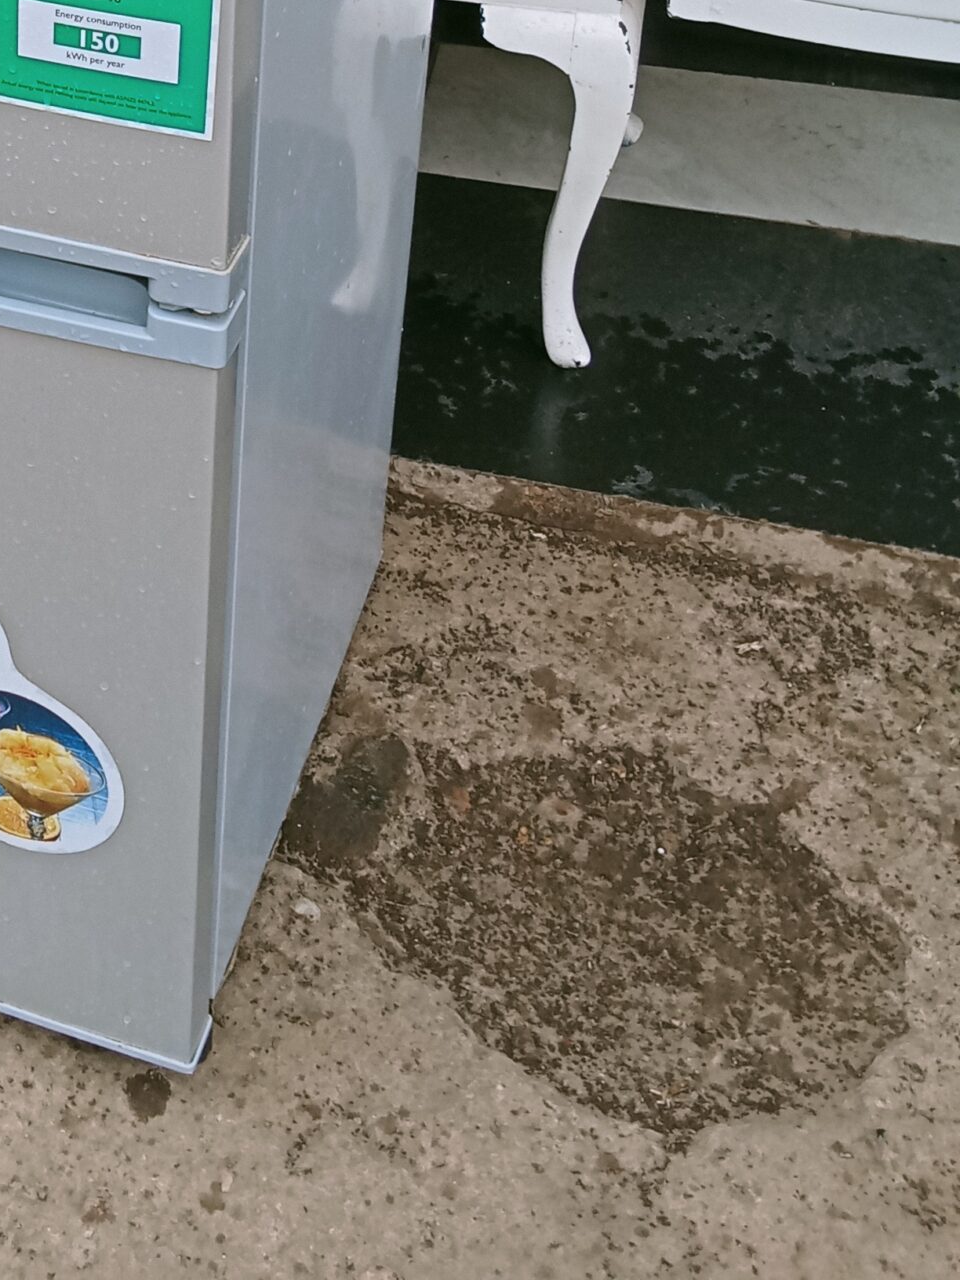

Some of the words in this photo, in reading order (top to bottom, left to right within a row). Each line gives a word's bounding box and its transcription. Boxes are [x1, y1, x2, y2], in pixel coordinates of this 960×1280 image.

[55, 9, 84, 23] Energy
[86, 16, 142, 31] consumption
[80, 29, 120, 54] 150
[66, 51, 88, 61] kWh
[90, 57, 105, 65] per
[106, 60, 125, 68] year
